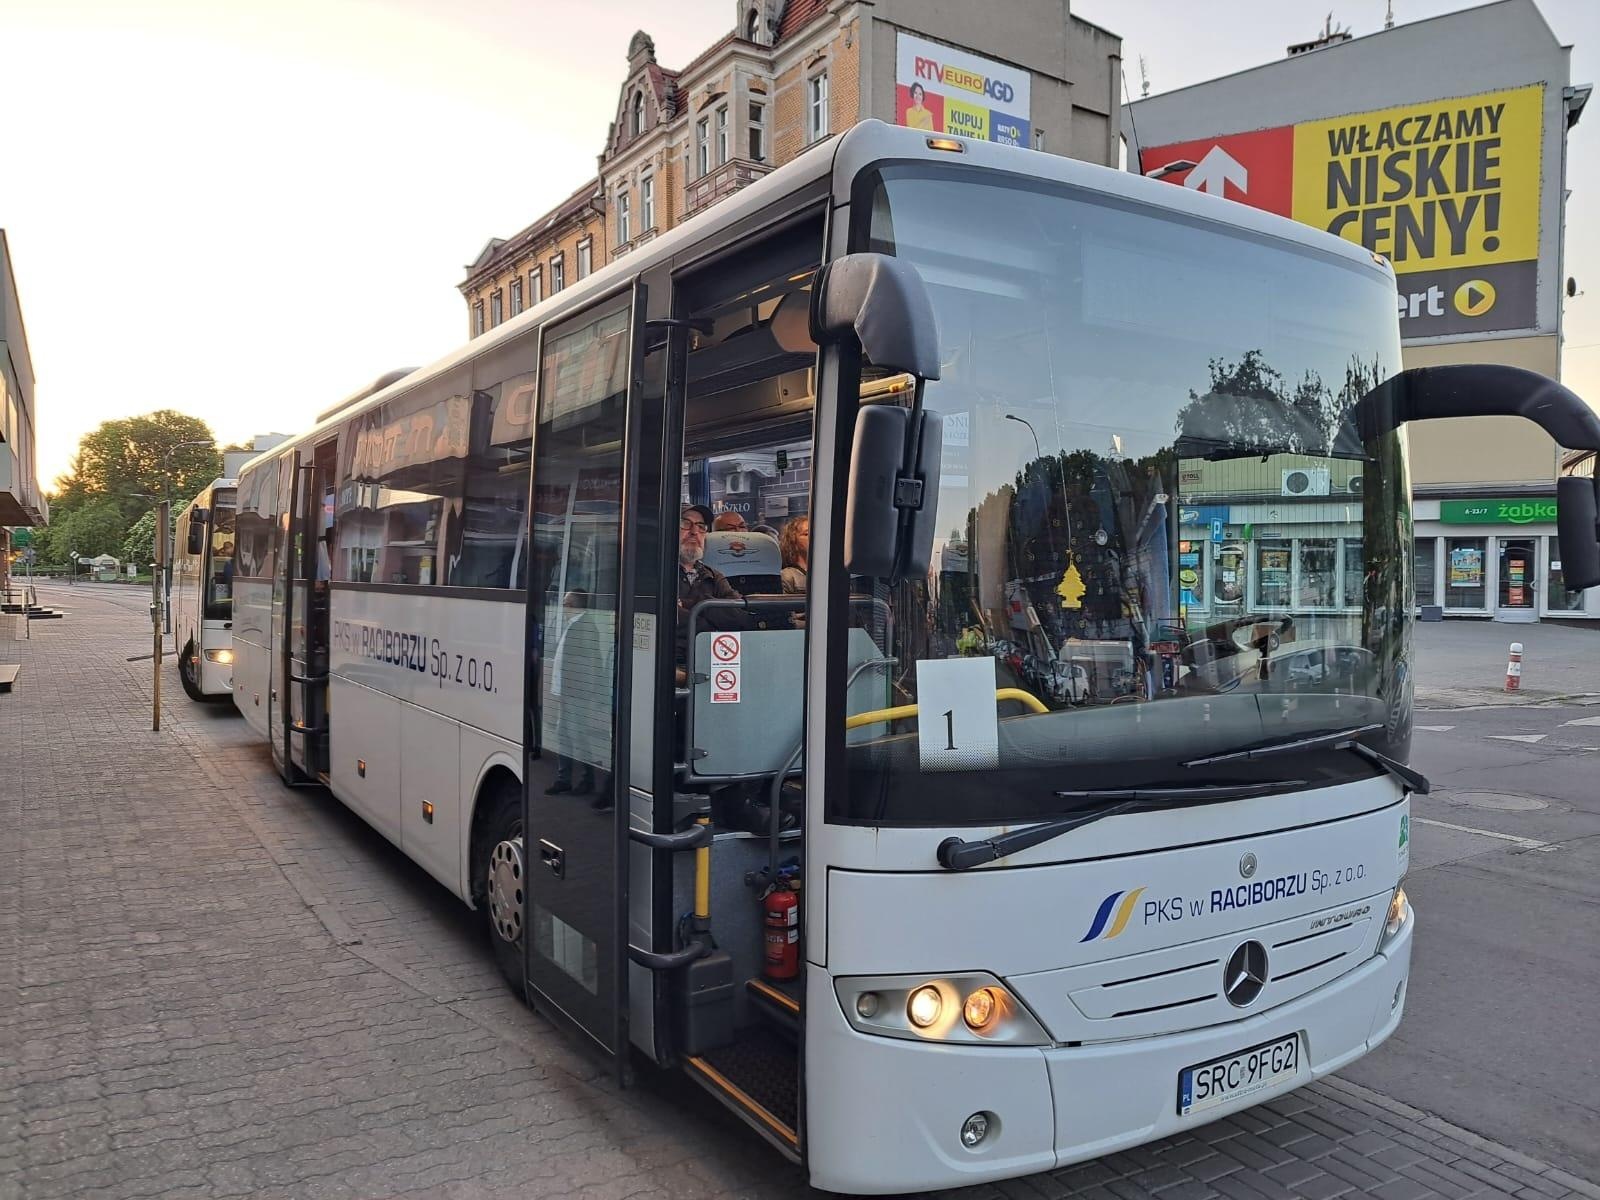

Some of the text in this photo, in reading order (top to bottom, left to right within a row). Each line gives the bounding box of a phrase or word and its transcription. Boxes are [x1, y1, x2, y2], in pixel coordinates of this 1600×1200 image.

[914, 55, 1014, 103] RTV EURO AGD
[950, 109, 983, 131] KUPUJ
[1327, 102, 1506, 157] WŁĄCZAMY
[1326, 137, 1501, 210] NISKIE
[1326, 192, 1501, 263] CENY!
[1497, 503, 1558, 518] żabka
[362, 625, 427, 673] RACIBORZU
[430, 639, 452, 689] Sp.
[455, 654, 463, 684] z
[941, 709, 959, 751] 1
[1144, 863, 1367, 926] PKS w RACIBORZU Sp. z o.o.
[1195, 1059, 1241, 1100] SRC
[1247, 1041, 1294, 1084] 9FG2
